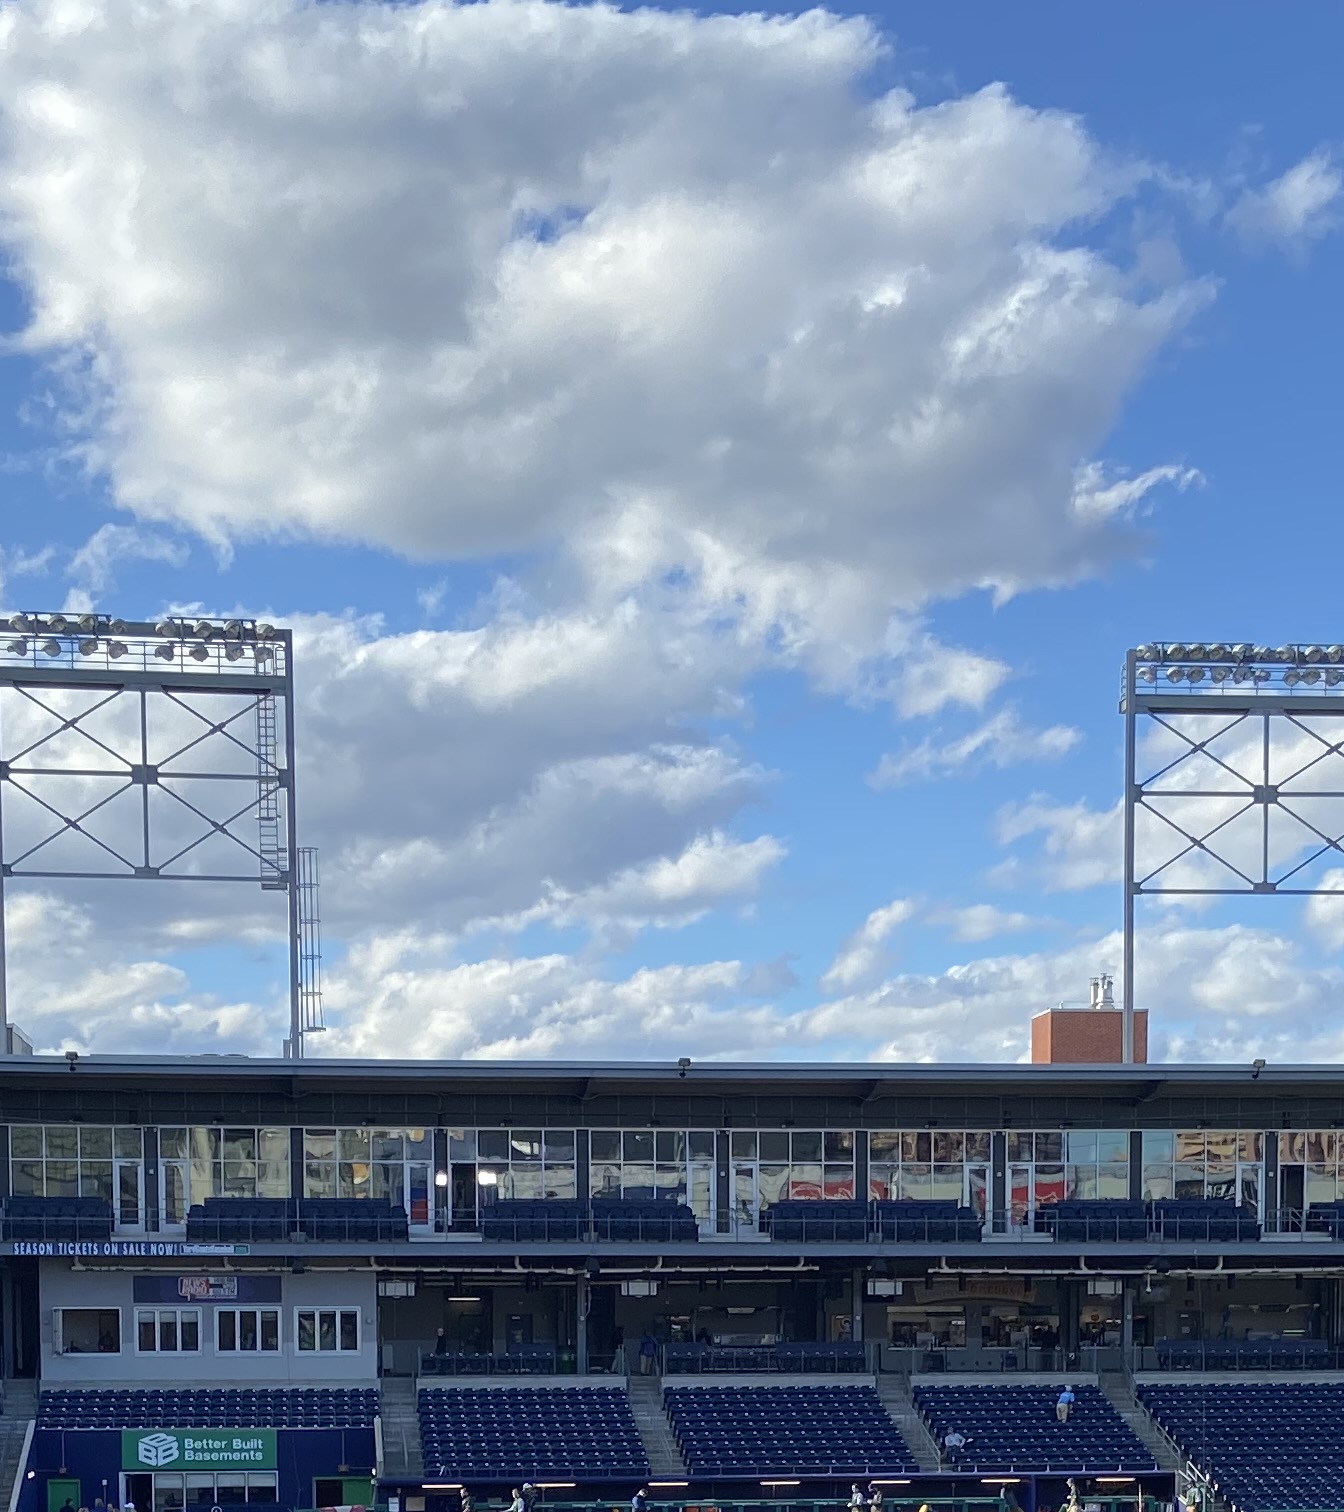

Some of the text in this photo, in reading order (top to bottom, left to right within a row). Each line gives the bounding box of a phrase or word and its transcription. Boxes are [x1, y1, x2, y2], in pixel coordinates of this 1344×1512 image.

[13, 1242, 177, 1255] SEASON TICKETS ON SALE NOW!
[184, 1438, 263, 1449] Better Built
[184, 1450, 263, 1461] Basements
